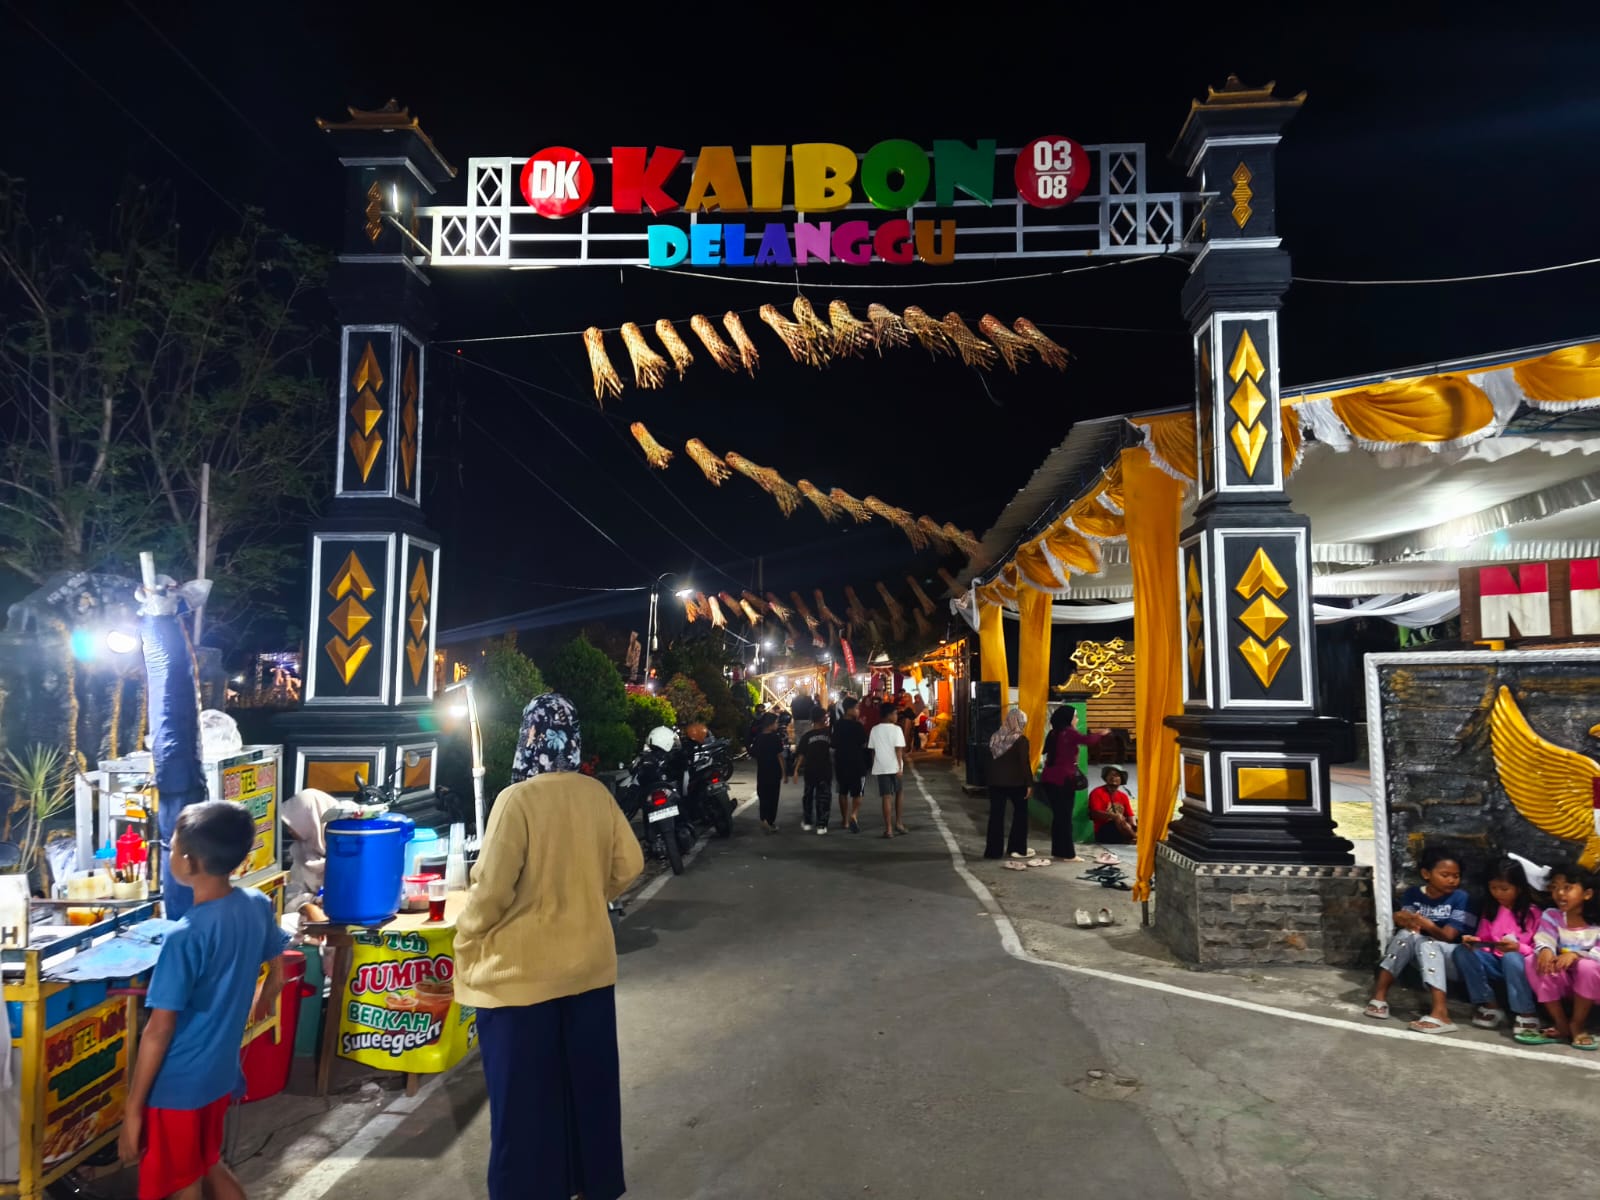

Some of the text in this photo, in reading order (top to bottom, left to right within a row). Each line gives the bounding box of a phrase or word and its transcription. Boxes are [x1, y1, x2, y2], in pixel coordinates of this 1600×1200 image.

[1033, 140, 1072, 171] 03
[531, 160, 581, 200] DK
[611, 138, 997, 216] KAIBON
[1037, 175, 1068, 199] 08
[647, 219, 957, 268] DELANGGU
[351, 955, 455, 995] JUMBO
[347, 1001, 432, 1033] BERKAH
